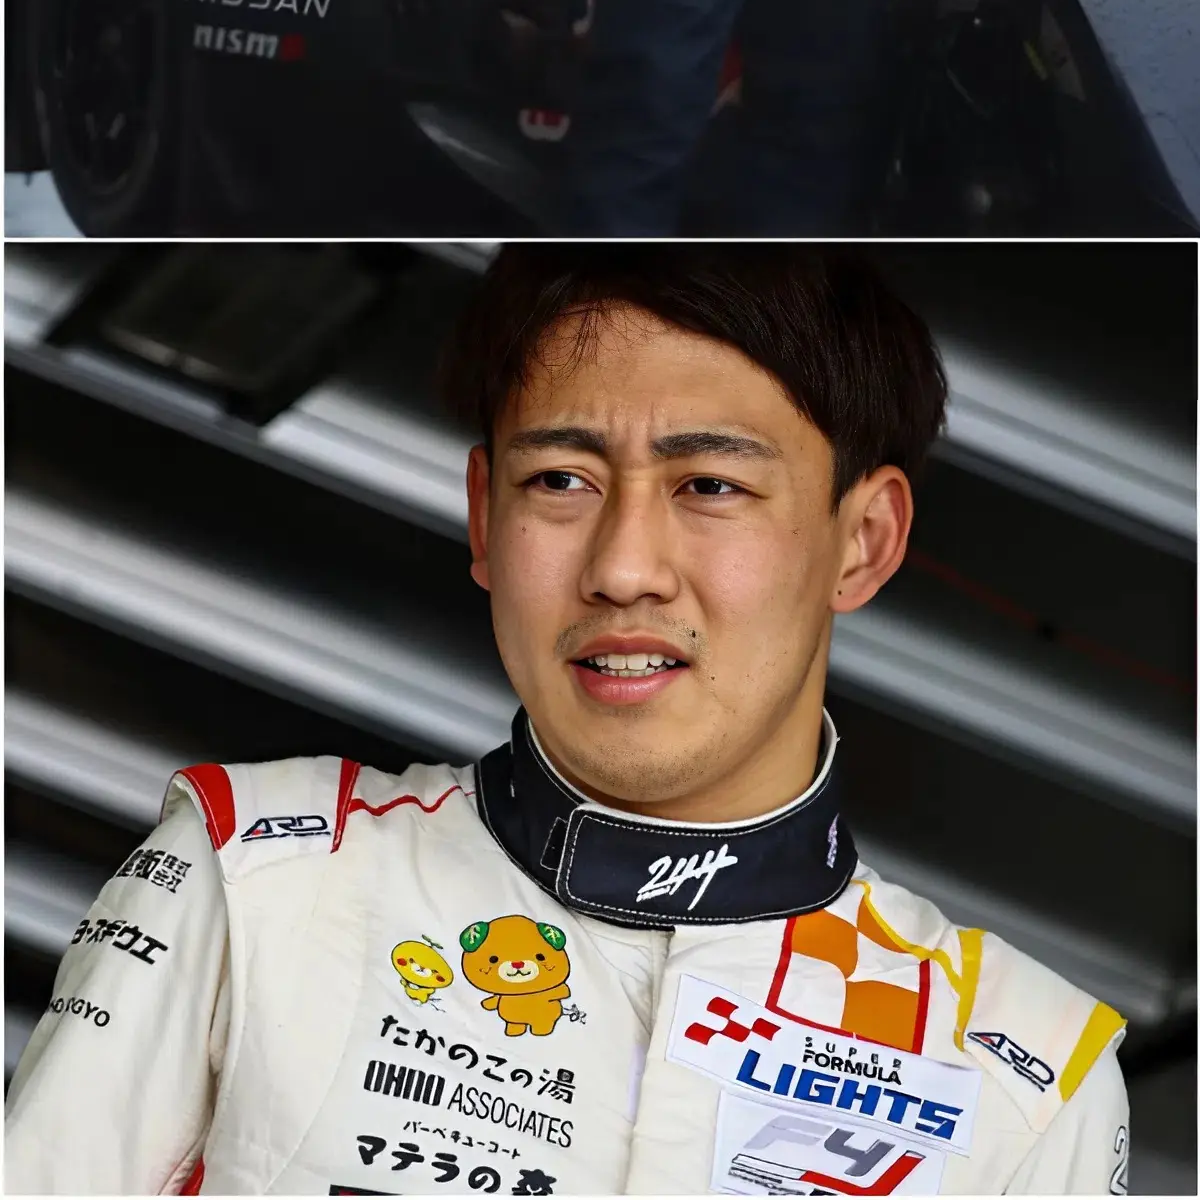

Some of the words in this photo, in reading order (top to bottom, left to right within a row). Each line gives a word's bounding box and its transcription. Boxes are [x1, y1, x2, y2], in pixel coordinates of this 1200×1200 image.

[380, 1014, 576, 1104] たかのこの湯
[735, 1048, 964, 1141] LIGHTS
[802, 1049, 902, 1086] FORMULA
[447, 1082, 574, 1148] ASSOCIATES
